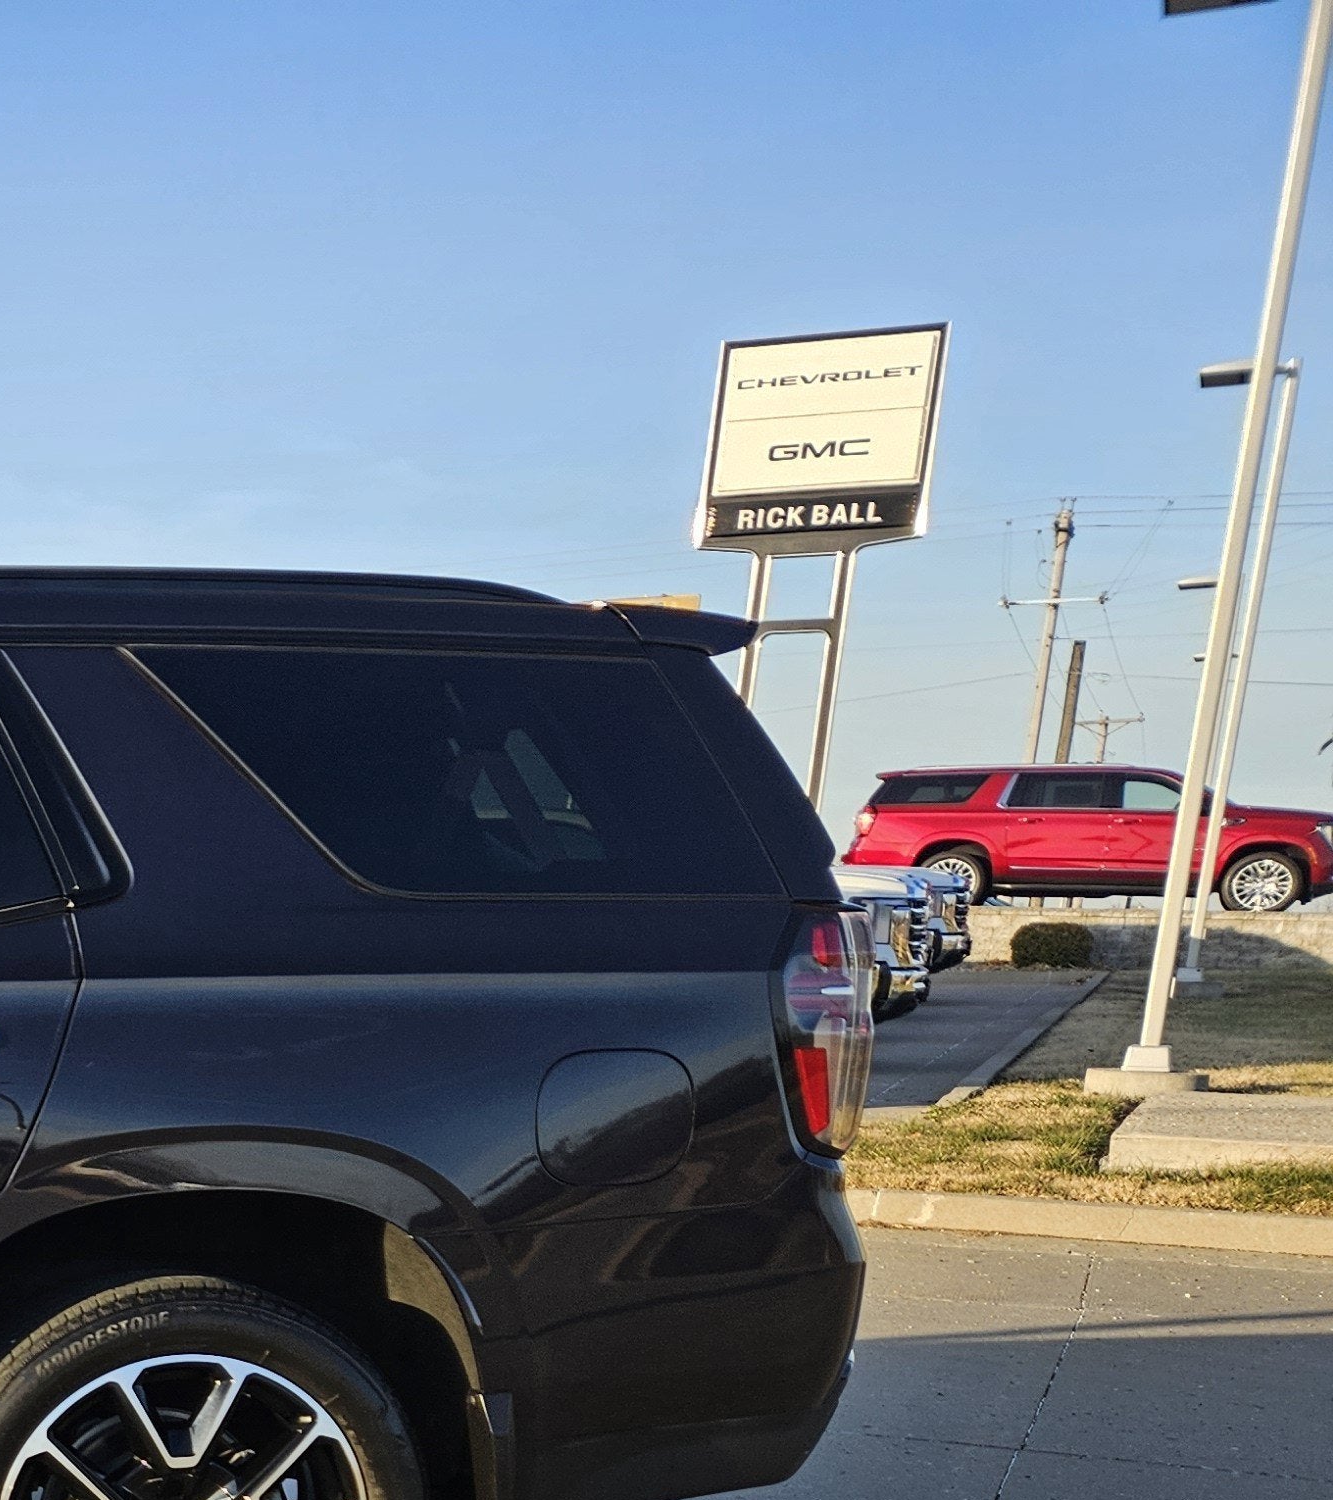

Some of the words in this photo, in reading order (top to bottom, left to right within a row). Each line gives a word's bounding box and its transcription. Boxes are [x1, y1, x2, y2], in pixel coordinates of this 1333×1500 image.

[737, 364, 923, 390] CHEVROLET
[767, 438, 871, 462] GMC
[737, 504, 806, 531] RICK
[810, 501, 884, 526] BALL
